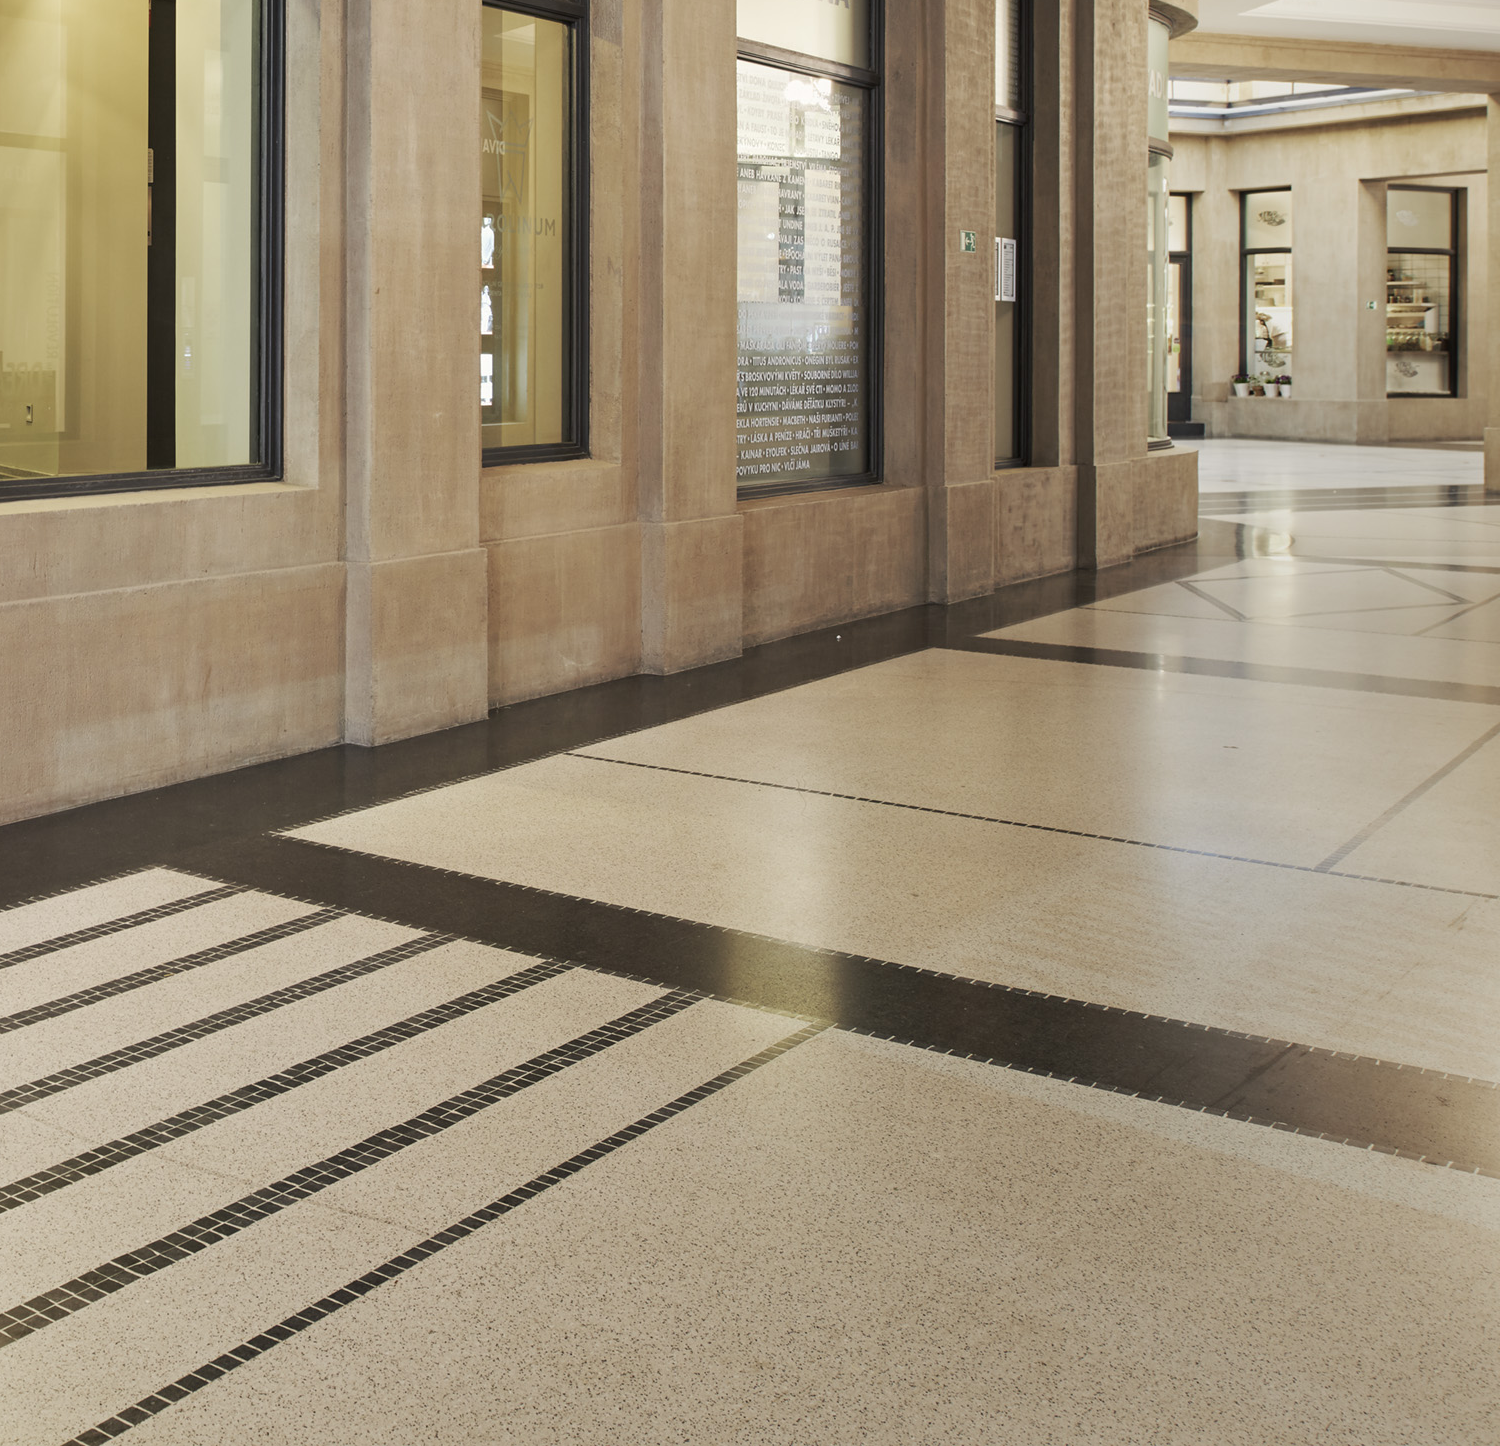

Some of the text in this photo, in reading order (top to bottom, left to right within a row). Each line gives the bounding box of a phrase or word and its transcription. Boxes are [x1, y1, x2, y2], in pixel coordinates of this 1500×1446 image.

[740, 167, 754, 179] ANEB
[753, 356, 766, 366] TITUS
[767, 356, 802, 366] ANDRONICUS
[745, 369, 784, 382] BROSKVOVÝMI
[785, 369, 801, 381] KVĚTY
[804, 368, 831, 380] SOUBORNÉ
[831, 367, 842, 379] DÍLO
[741, 387, 748, 397] VE
[759, 384, 787, 396] MINUTÁCH
[790, 383, 805, 395] LÉKAŘ
[806, 383, 815, 395] SVÉ
[826, 384, 842, 394] MOMO
[754, 402, 779, 412] KUCHYNI
[782, 398, 803, 411] DÁVÁME
[804, 397, 825, 410] DĚŤÁTKU
[737, 418, 750, 428] EKLA
[751, 416, 779, 428] HORTENSIE
[783, 415, 806, 426] MACBETH
[809, 412, 821, 424] NAŠI
[822, 414, 843, 423] FURIANTI
[751, 431, 768, 443] LÁSKA
[775, 429, 792, 442] PENÍZE
[796, 427, 811, 440] HRÁČI
[822, 425, 848, 438] MUŠKETÝŘI
[741, 449, 762, 460] KAINAR
[766, 447, 788, 458] EYOLFEK
[791, 443, 809, 456] SLEČNA
[810, 440, 831, 454] JAIROVÁ
[834, 442, 839, 452] O
[839, 439, 850, 451] LÍNÉ
[737, 459, 811, 476] POVYKU PRO NIC VLČÍ JÁMA
